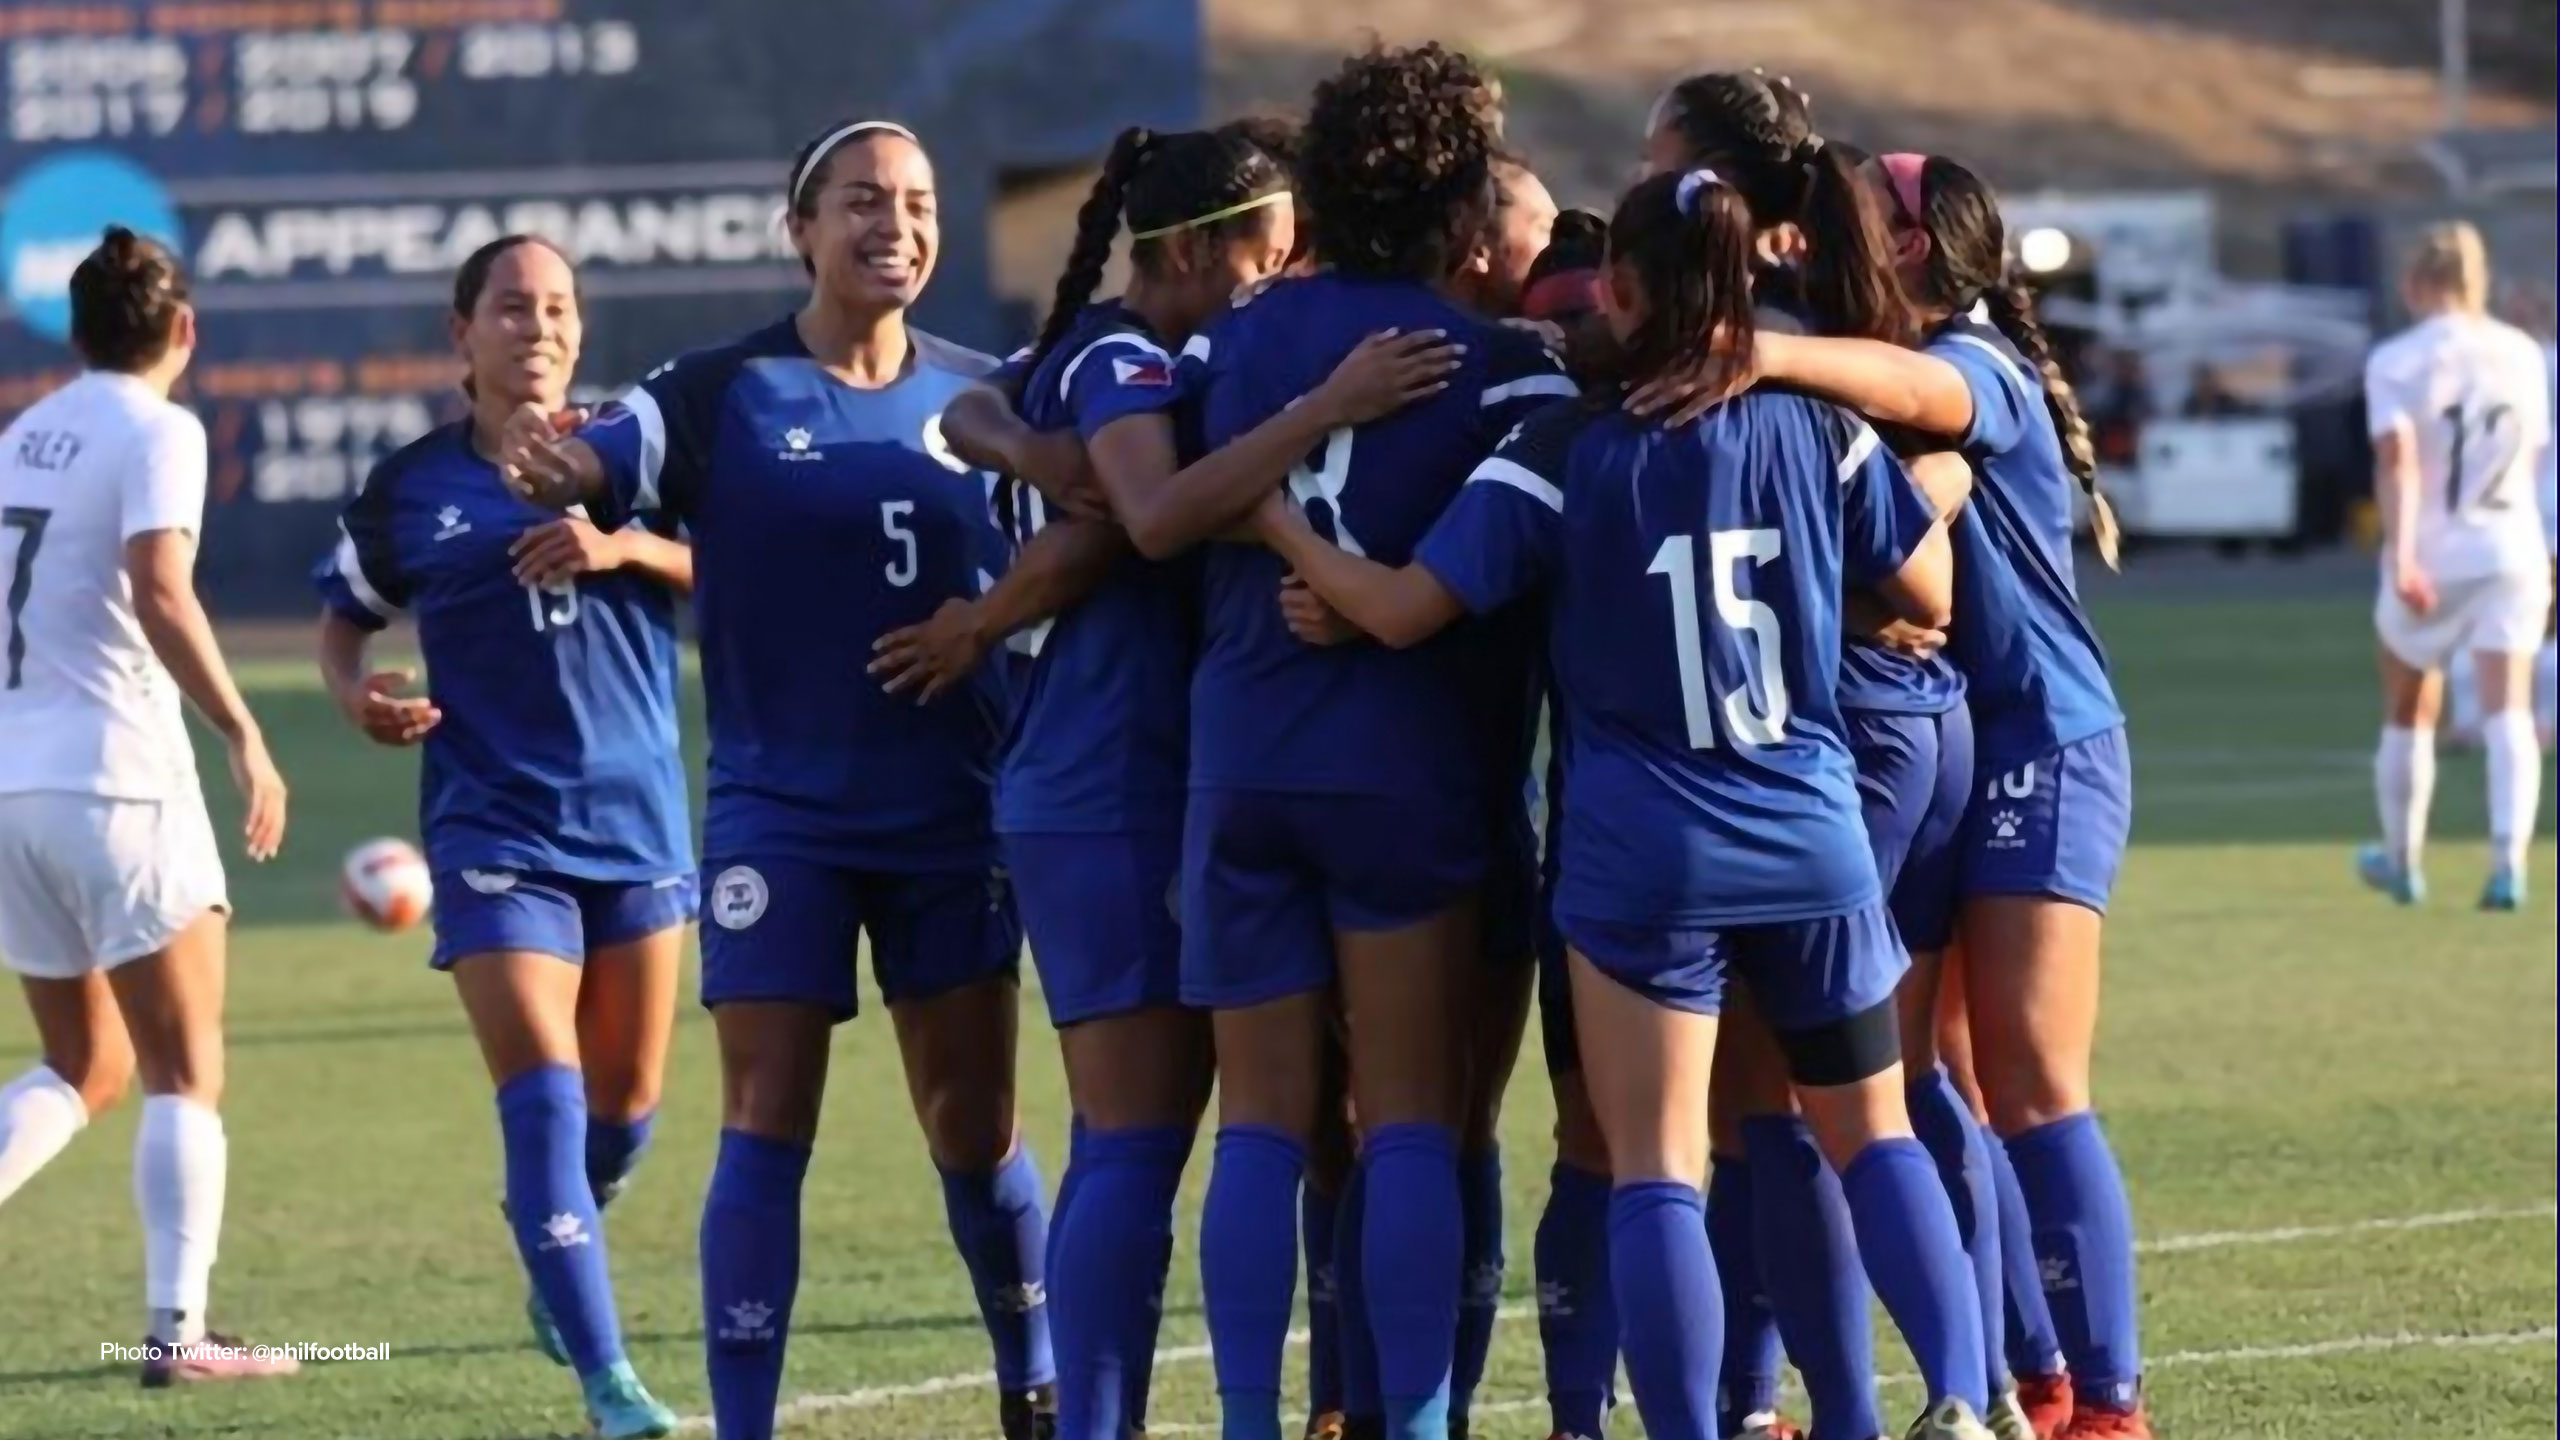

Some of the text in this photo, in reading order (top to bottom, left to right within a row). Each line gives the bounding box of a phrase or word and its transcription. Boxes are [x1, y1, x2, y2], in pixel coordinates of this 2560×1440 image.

[16, 430, 82, 471] RILEY
[2440, 401, 2525, 516] 12
[0, 505, 54, 691] 7
[880, 499, 919, 588] 5
[1645, 527, 1788, 750] 15
